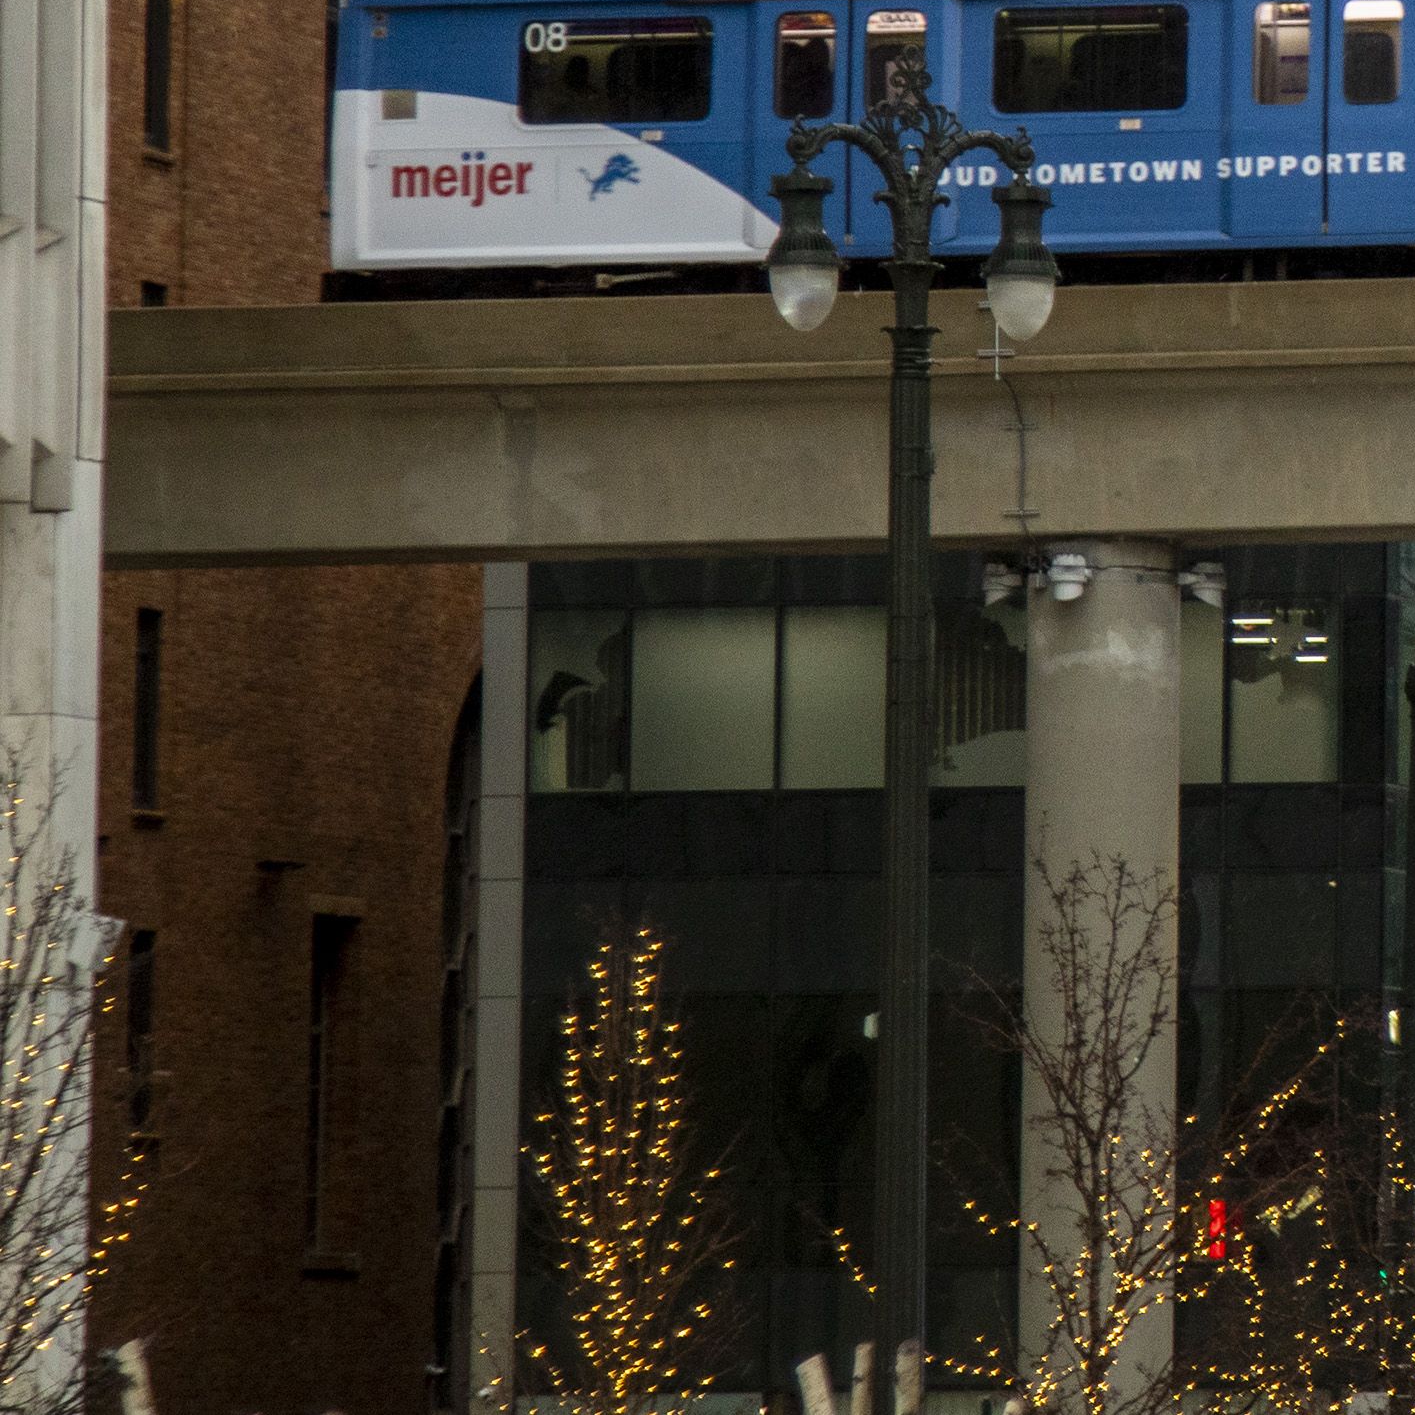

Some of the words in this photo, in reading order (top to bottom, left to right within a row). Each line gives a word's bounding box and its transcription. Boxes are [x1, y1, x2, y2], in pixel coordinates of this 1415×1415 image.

[524, 22, 568, 53] 08
[391, 151, 534, 208] meijer
[1216, 151, 1406, 179] SUPPORTER
